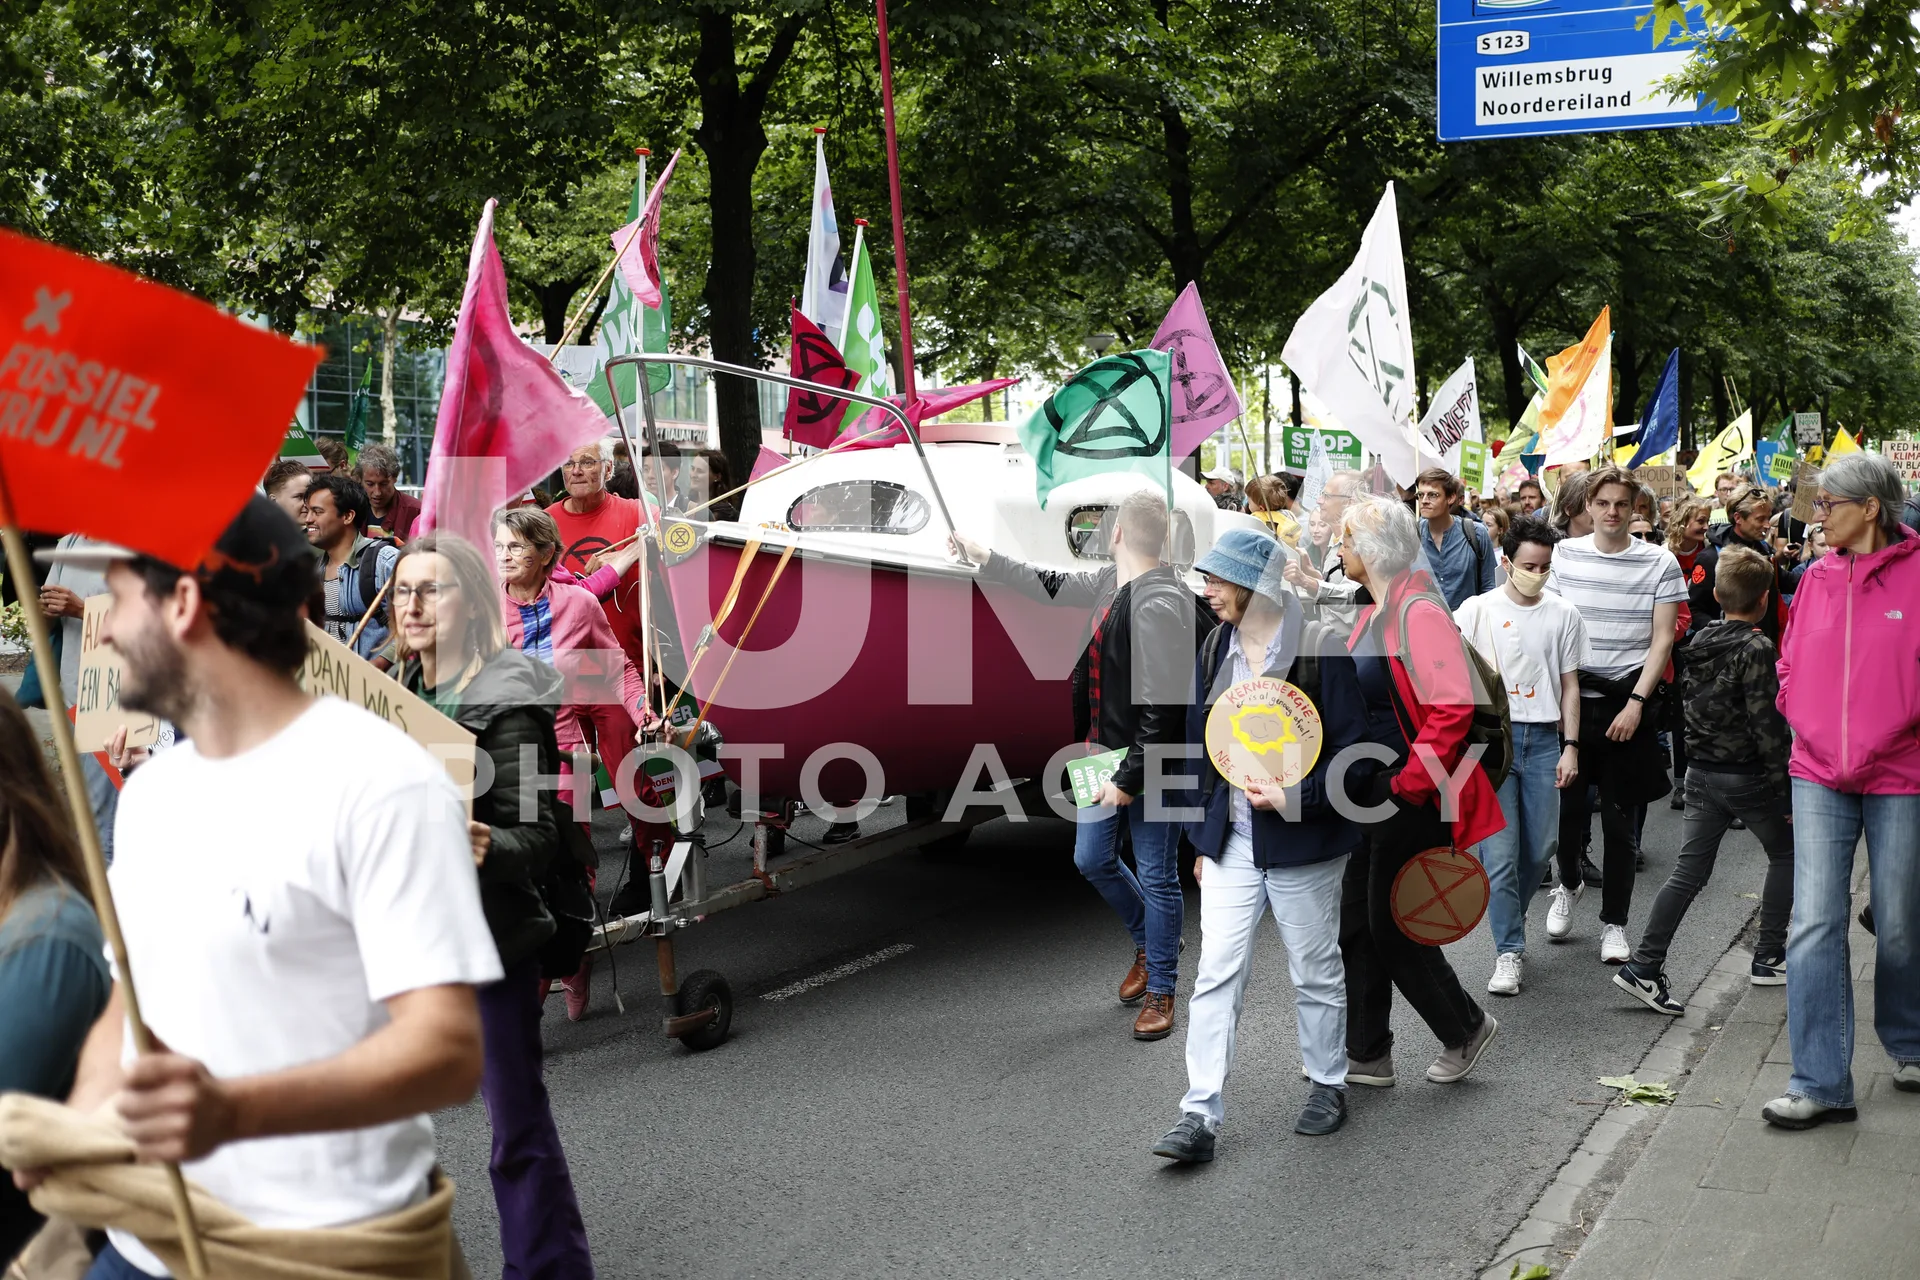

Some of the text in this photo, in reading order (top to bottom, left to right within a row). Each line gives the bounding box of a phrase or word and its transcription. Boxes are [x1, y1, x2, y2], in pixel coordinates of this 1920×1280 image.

[1481, 34, 1524, 51] S 123
[1482, 67, 1612, 88] Willemsbrug
[1482, 91, 1631, 116] Noordereiland
[0, 389, 127, 469] RIJ NL
[290, 430, 304, 439] NU
[1890, 442, 1920, 452] RED H
[1291, 455, 1303, 465] IN
[79, 667, 101, 713] EEN
[311, 638, 409, 734] DAN WAS
[1259, 692, 1268, 701] al
[1073, 768, 1089, 800] DE TIJD
